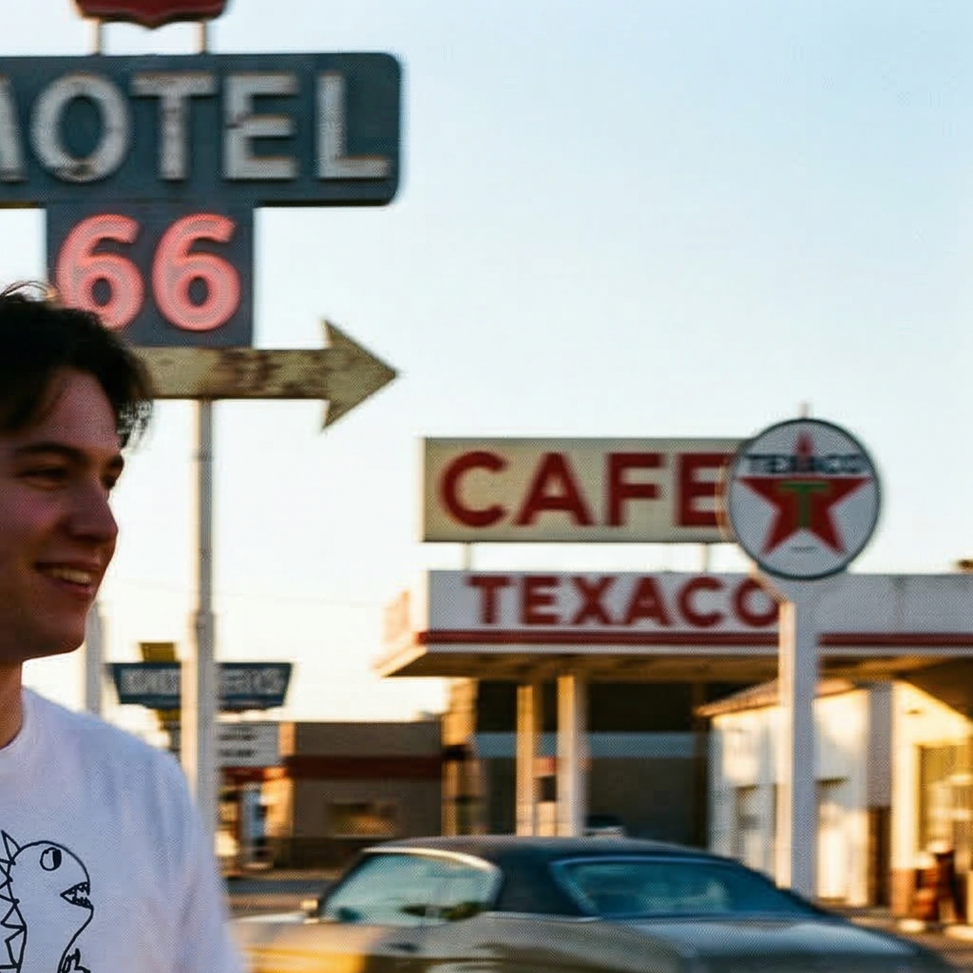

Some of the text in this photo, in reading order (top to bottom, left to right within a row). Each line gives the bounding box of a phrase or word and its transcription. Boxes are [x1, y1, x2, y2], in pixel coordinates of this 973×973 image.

[56, 213, 242, 331] 66
[438, 450, 735, 528] CAFE
[466, 576, 779, 627] TEXACO
